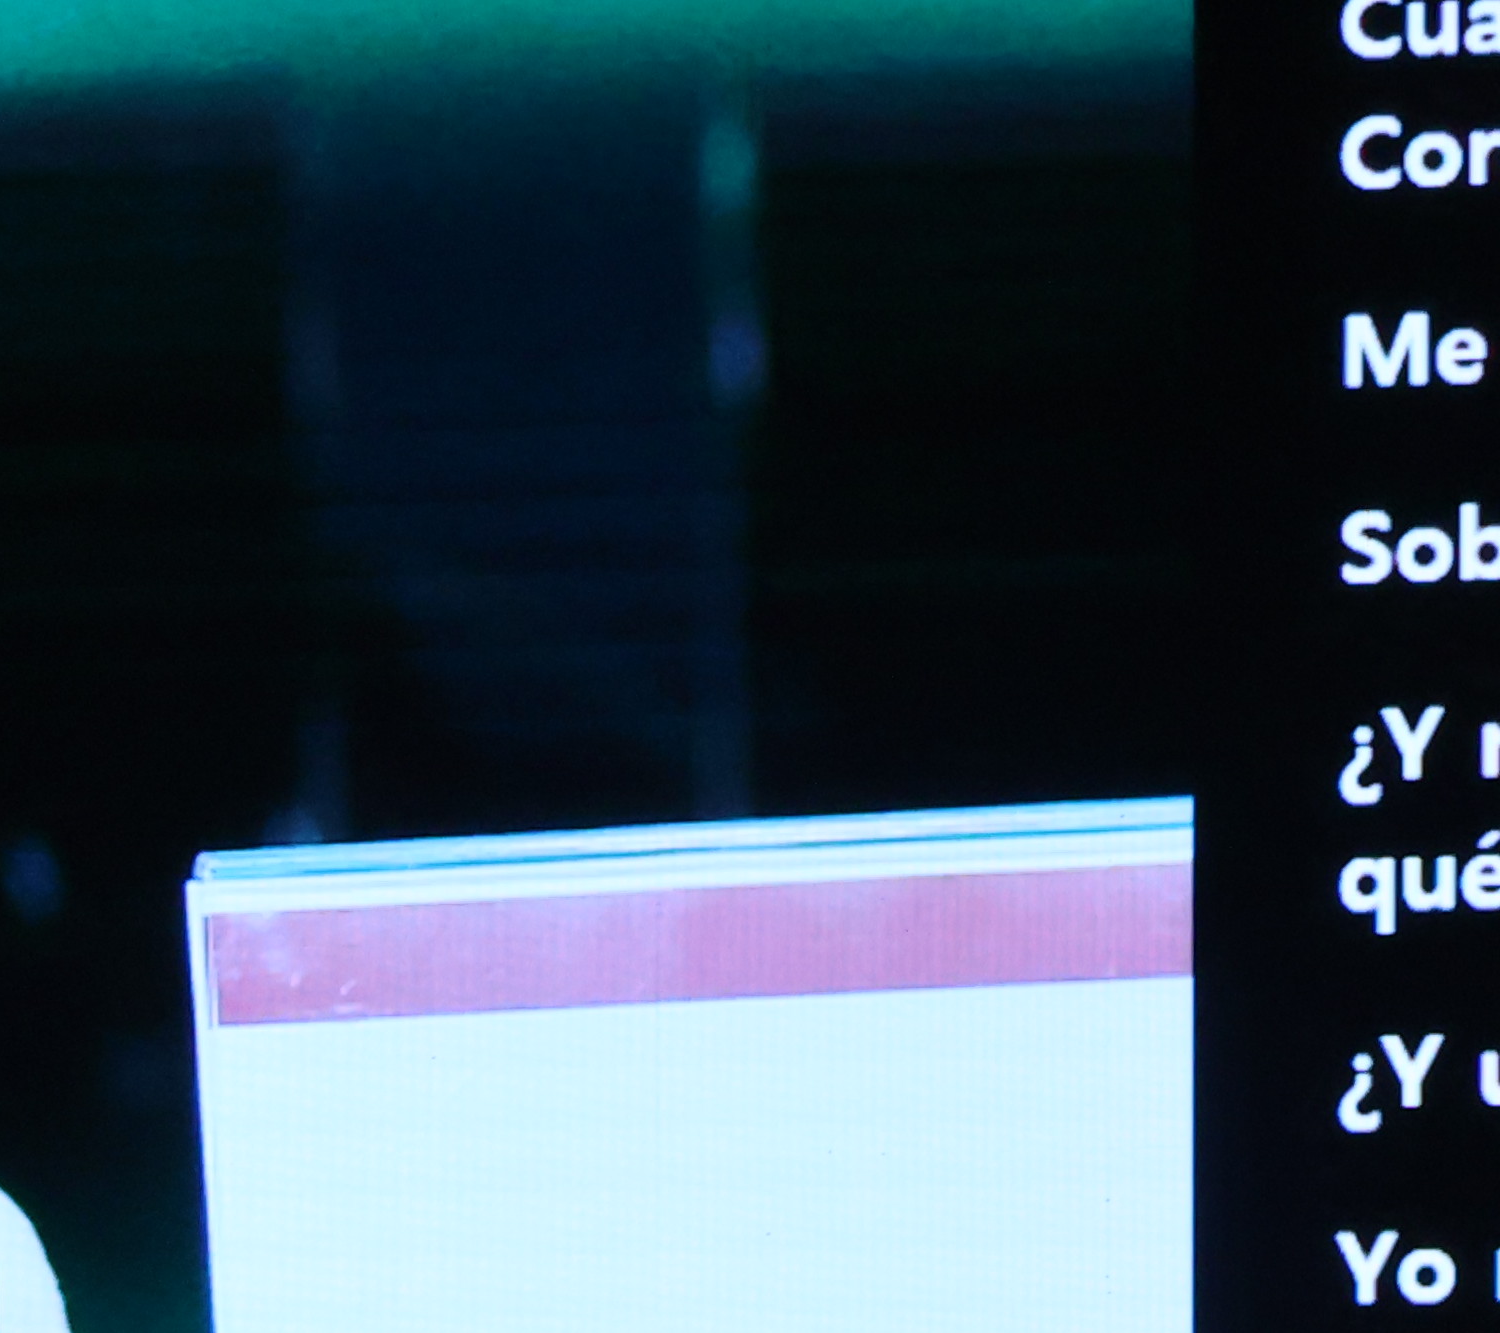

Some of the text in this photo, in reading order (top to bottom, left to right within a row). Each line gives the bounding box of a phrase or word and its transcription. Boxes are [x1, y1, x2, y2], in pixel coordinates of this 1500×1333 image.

[1343, 310, 1488, 389] Me
[1340, 502, 1500, 585] Sob
[1338, 705, 1445, 806] ¿Y
[1338, 829, 1500, 936] qué
[1337, 1033, 1445, 1133] ¿Y
[1335, 1230, 1456, 1306] Yo
